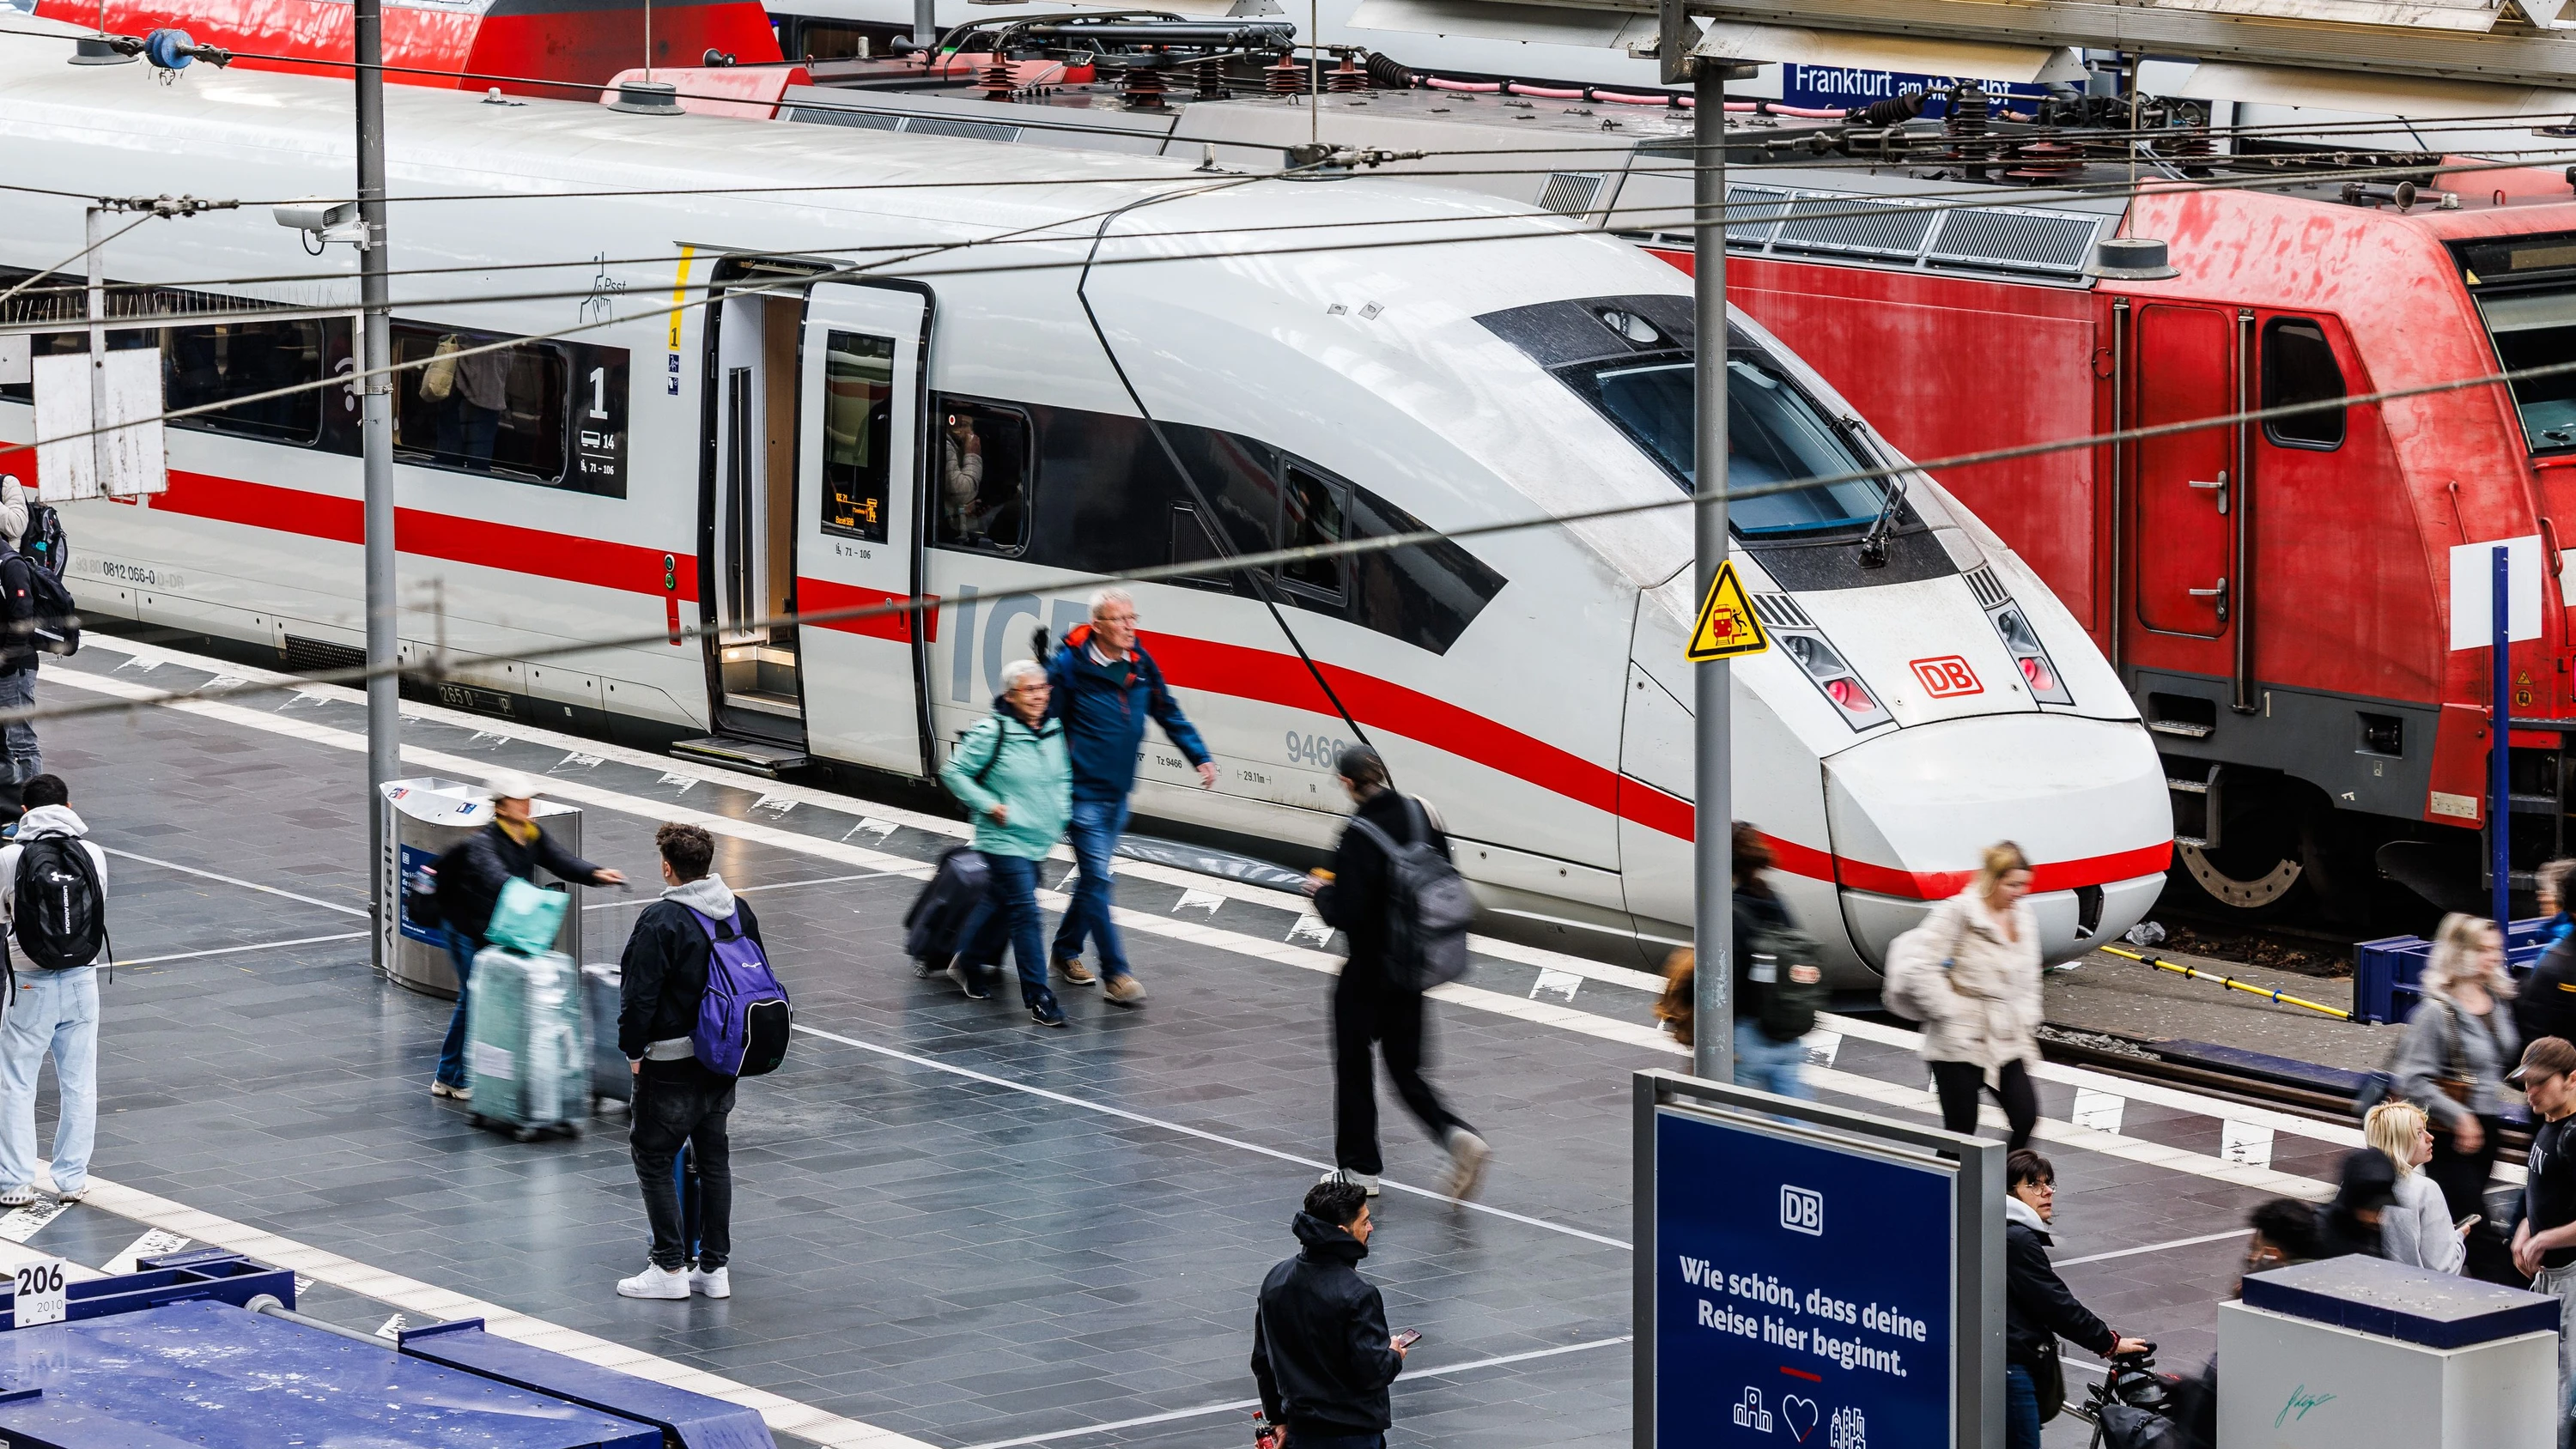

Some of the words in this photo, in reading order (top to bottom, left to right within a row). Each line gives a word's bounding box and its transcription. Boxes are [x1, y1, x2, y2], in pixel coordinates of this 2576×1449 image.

[1795, 64, 1893, 96] Frankfurt
[1898, 81, 1922, 97] am
[604, 277, 626, 296] Psst
[671, 327, 678, 347] 1
[589, 367, 608, 420] 1
[603, 433, 615, 450] 14
[589, 463, 597, 473] 71
[603, 464, 614, 475] 106
[845, 547, 853, 557] 71
[860, 549, 871, 560] 106
[76, 556, 88, 572] 93
[89, 560, 101, 575] 80
[103, 561, 126, 579] 0812
[128, 566, 155, 585] 066-0
[440, 686, 464, 704] 265
[1156, 755, 1165, 766] Tz
[1166, 758, 1182, 769] 9466
[384, 845, 393, 949] Abfall
[17, 1264, 64, 1297] 206
[37, 1299, 63, 1313] 2010
[1680, 1255, 1723, 1291] Wie
[1728, 1272, 1801, 1315] schön,
[1806, 1288, 1856, 1325] dass
[1862, 1302, 1927, 1342] deine
[1698, 1298, 1758, 1338] Reise
[1764, 1315, 1808, 1351] hier
[1813, 1327, 1907, 1377] beginnt.
